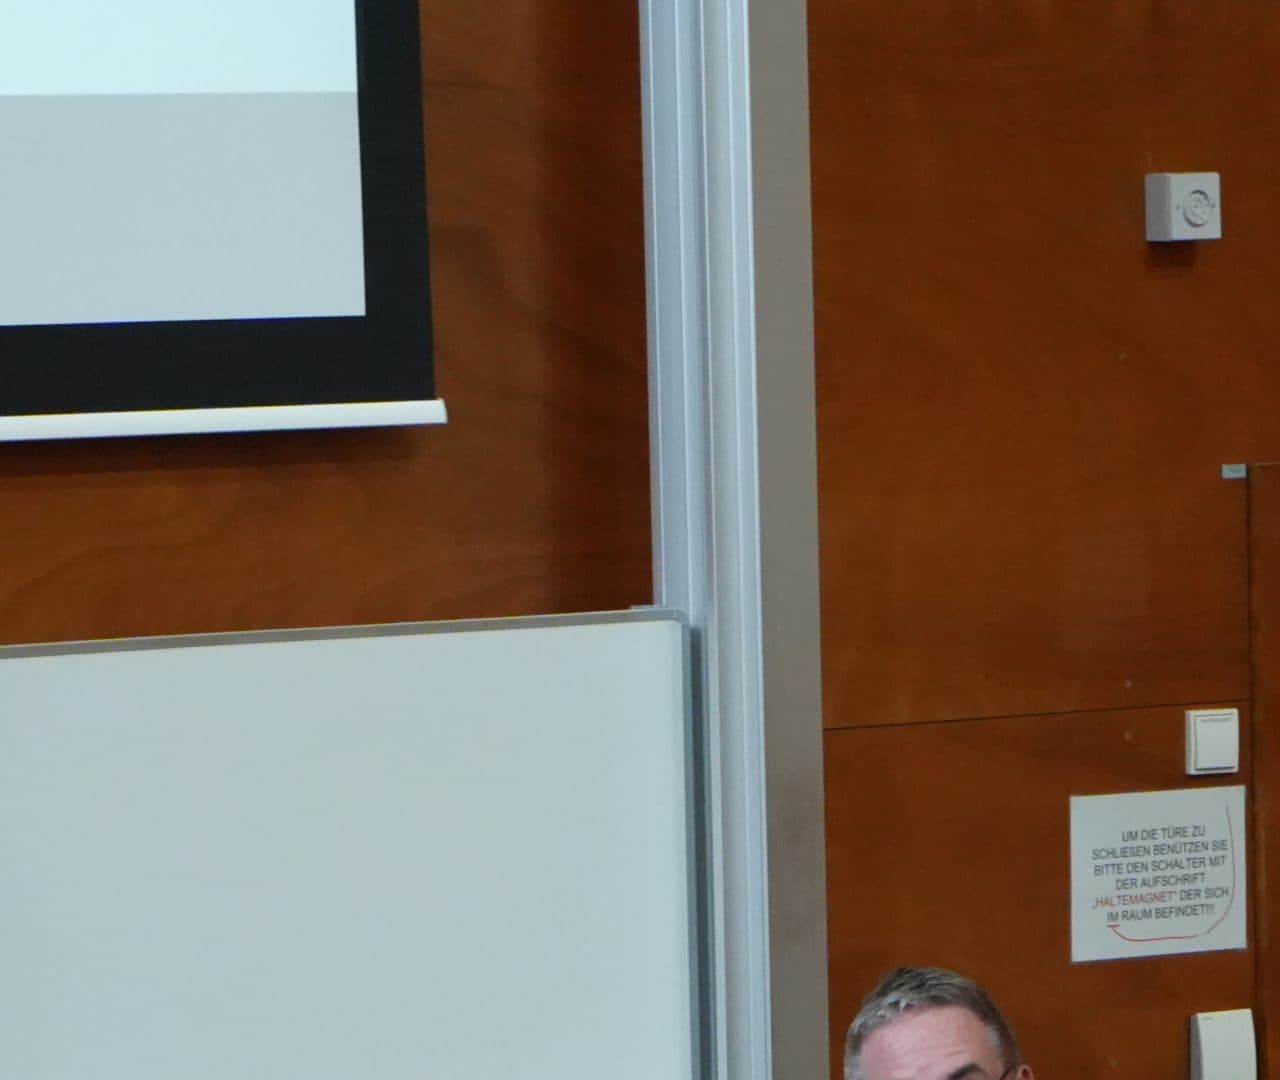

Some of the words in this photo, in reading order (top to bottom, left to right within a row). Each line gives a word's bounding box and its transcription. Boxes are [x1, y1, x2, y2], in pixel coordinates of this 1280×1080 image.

[1122, 831, 1138, 842] UM
[1141, 828, 1158, 841] DIE
[1160, 825, 1189, 839] TÜRE
[1192, 825, 1206, 837] ZU
[1153, 840, 1209, 856] BENÜTZEN
[1212, 840, 1228, 851] SIE
[1094, 863, 1123, 876] BITTE
[1126, 862, 1149, 873] DEN
[1151, 857, 1206, 872] SCHALTER
[1209, 855, 1226, 866] MIT
[1116, 878, 1138, 890] DER
[1140, 872, 1206, 888] AUFSCHRIFT
[1180, 888, 1201, 901] DER
[1204, 887, 1229, 899] SICH
[1107, 911, 1119, 922] IM
[1122, 908, 1152, 921] RAUM
